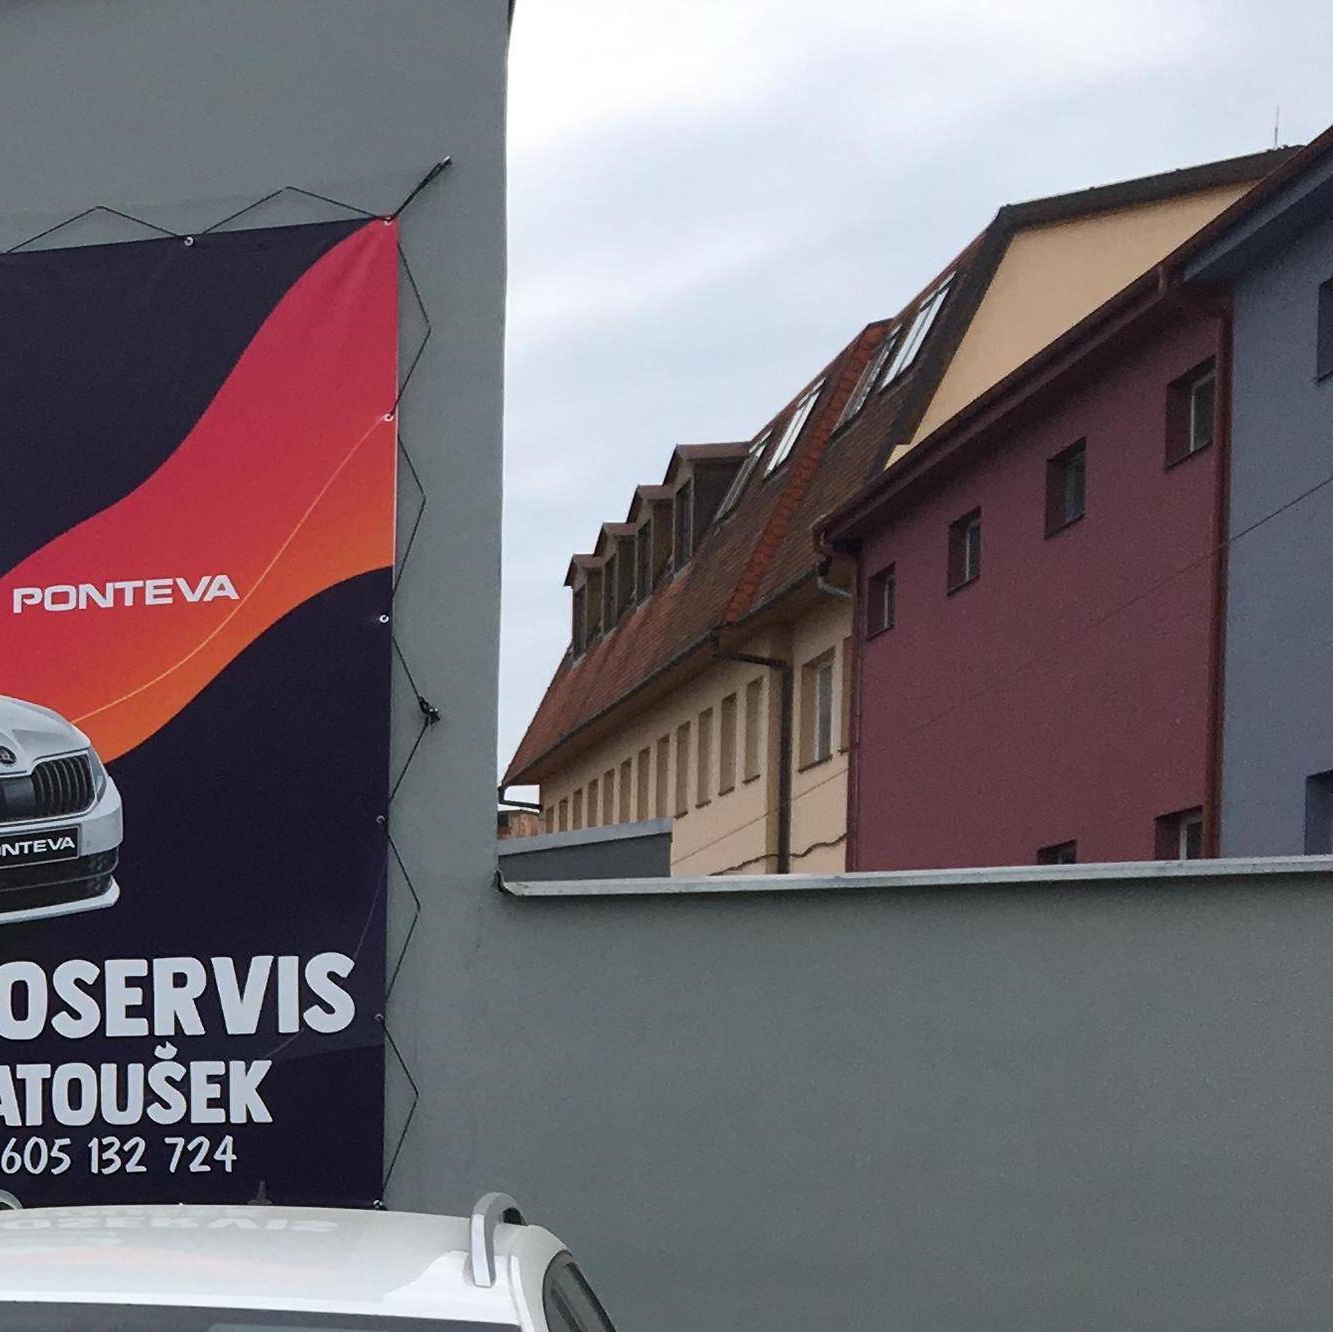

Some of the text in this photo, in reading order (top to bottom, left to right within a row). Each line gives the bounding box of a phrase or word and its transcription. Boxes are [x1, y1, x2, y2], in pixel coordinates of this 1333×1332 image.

[13, 574, 240, 614] PONTEVA
[87, 1136, 147, 1175] 132
[164, 1134, 238, 1174] 724
